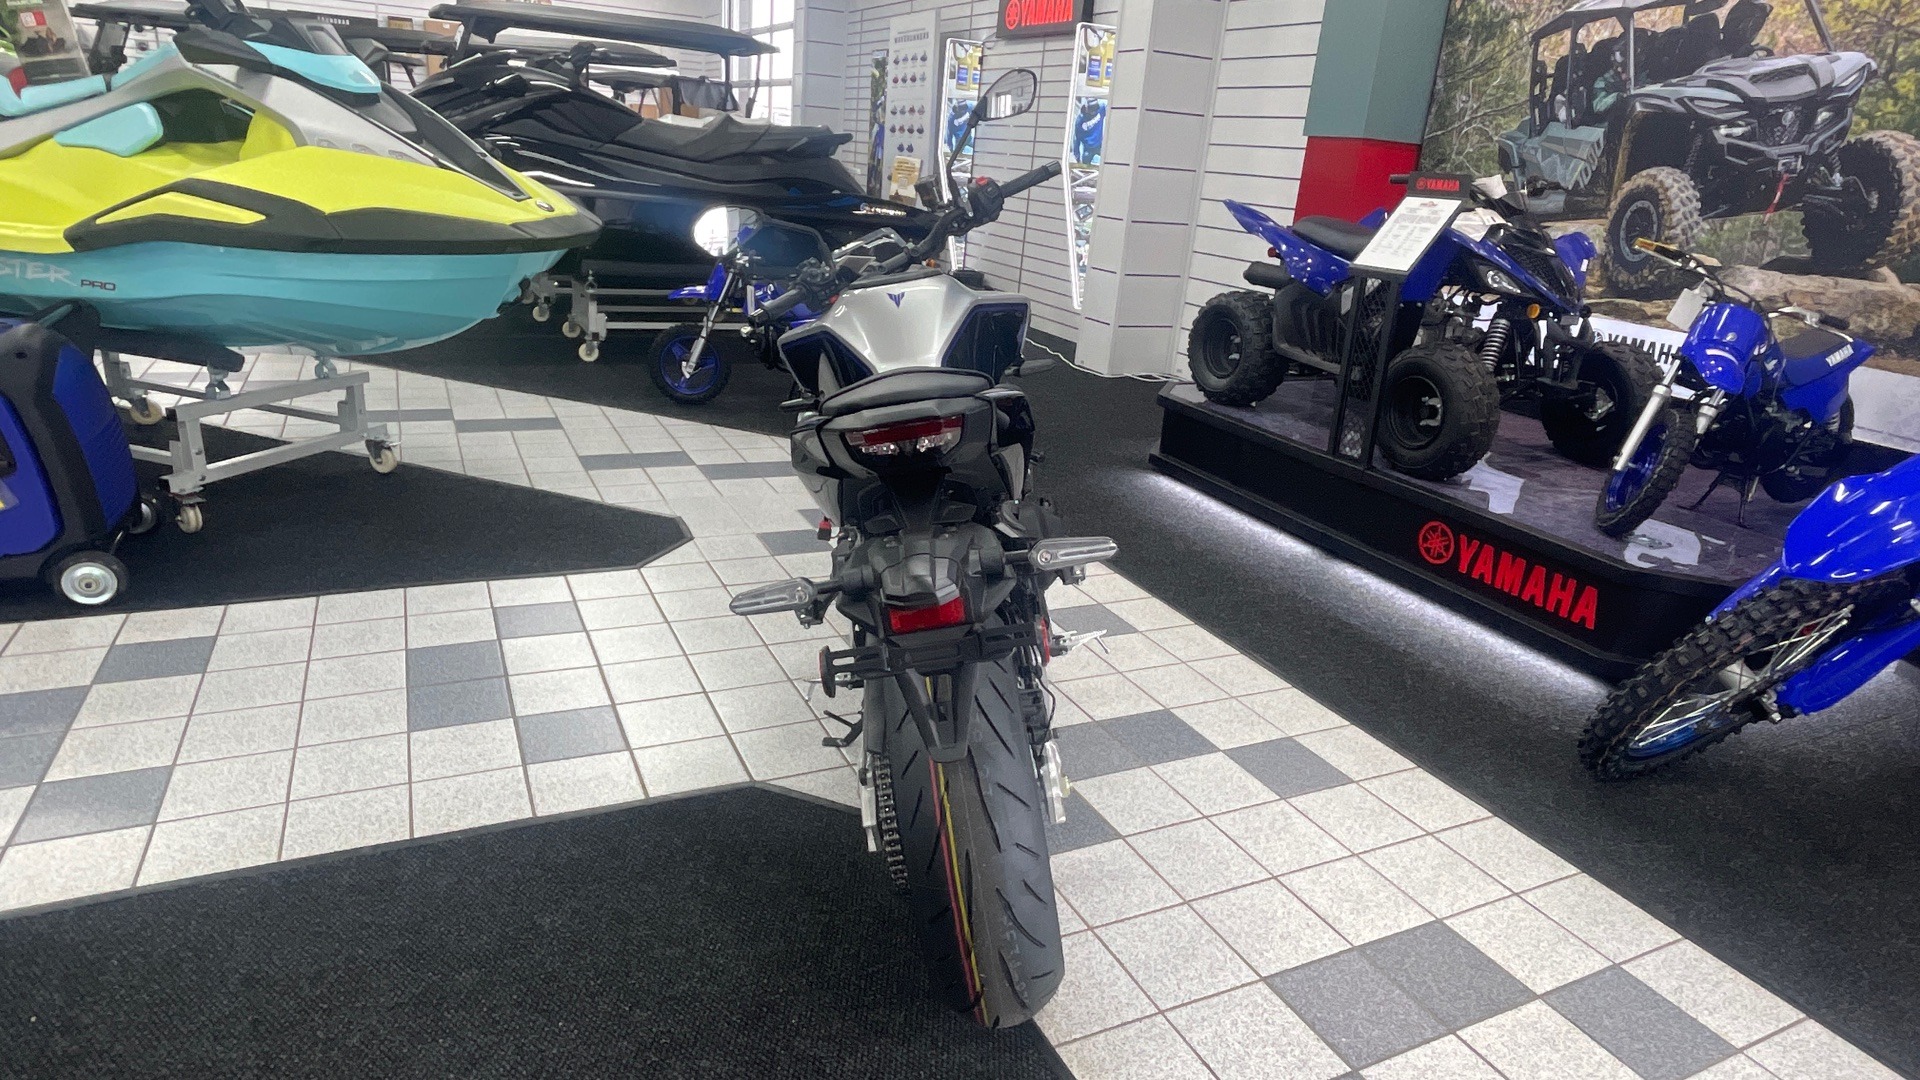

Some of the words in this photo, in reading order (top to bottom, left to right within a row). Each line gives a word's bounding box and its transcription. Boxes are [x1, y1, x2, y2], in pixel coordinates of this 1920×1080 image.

[1021, 0, 1073, 26] YAMAHA
[1426, 179, 1460, 191] YAMAHA
[80, 279, 116, 291] PRO
[1825, 344, 1855, 367] YAMAHA
[1458, 534, 1598, 631] YAMAHA
